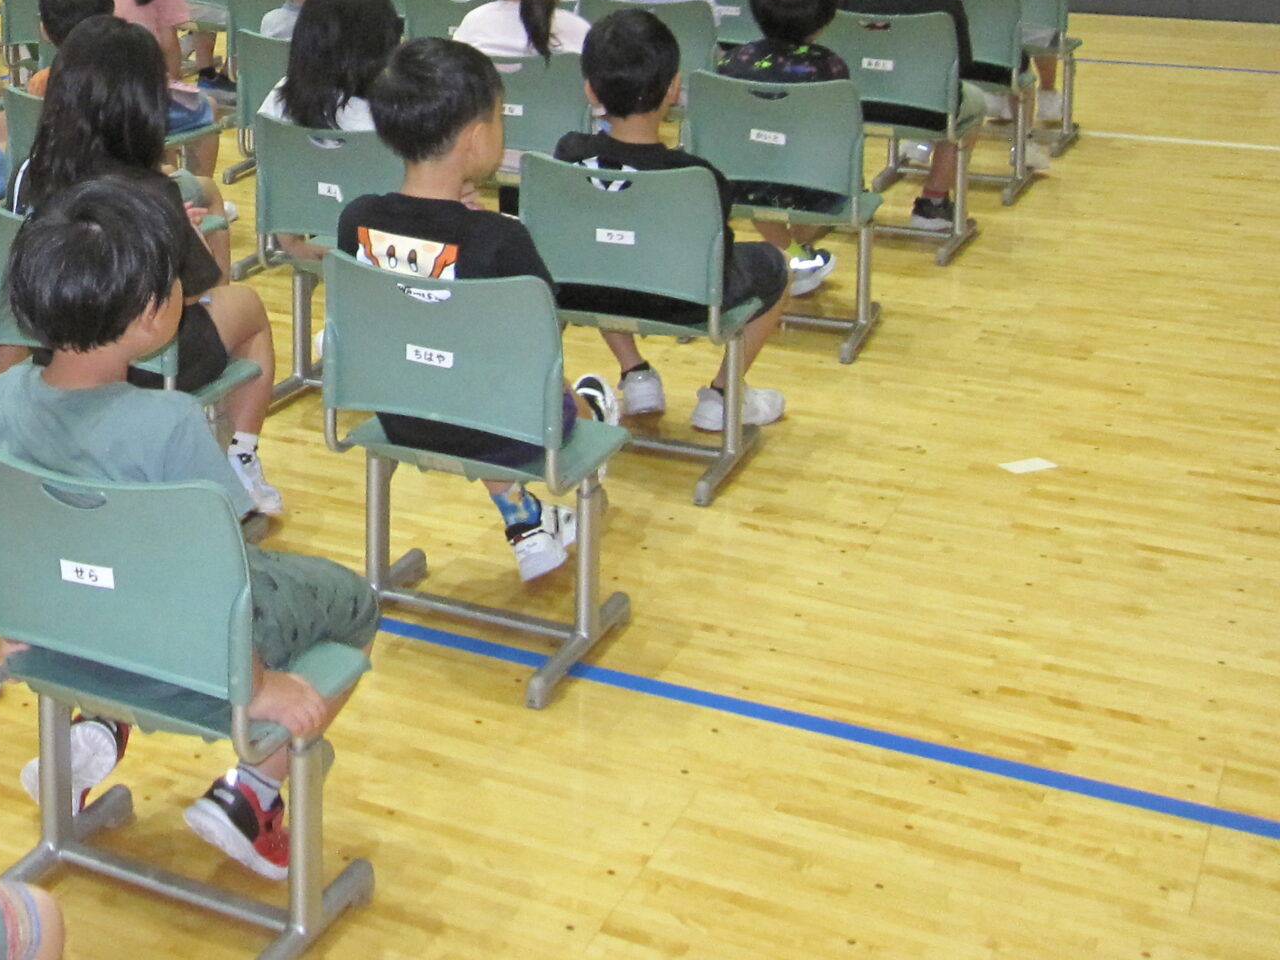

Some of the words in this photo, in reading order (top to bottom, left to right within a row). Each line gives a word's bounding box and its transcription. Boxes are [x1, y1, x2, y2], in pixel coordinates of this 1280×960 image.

[413, 349, 445, 364] ちはや
[73, 566, 99, 583] せら
